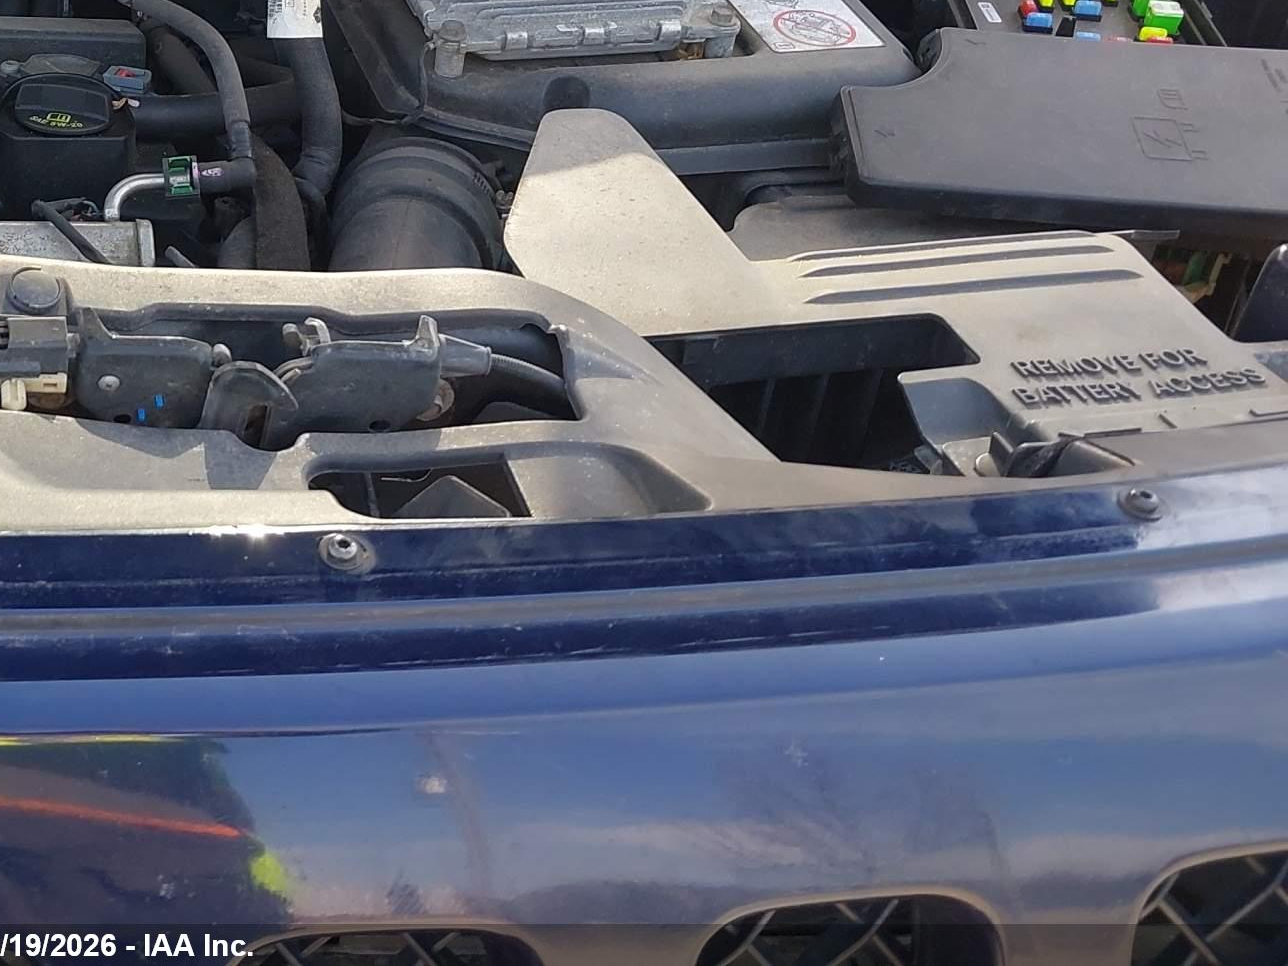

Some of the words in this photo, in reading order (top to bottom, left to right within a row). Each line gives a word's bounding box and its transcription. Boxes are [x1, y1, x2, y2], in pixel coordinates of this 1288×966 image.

[1010, 355, 1141, 378] REMOVE
[1139, 347, 1208, 370] FOR
[1011, 381, 1141, 406] BATTERY
[1148, 368, 1267, 398] ACCESS
